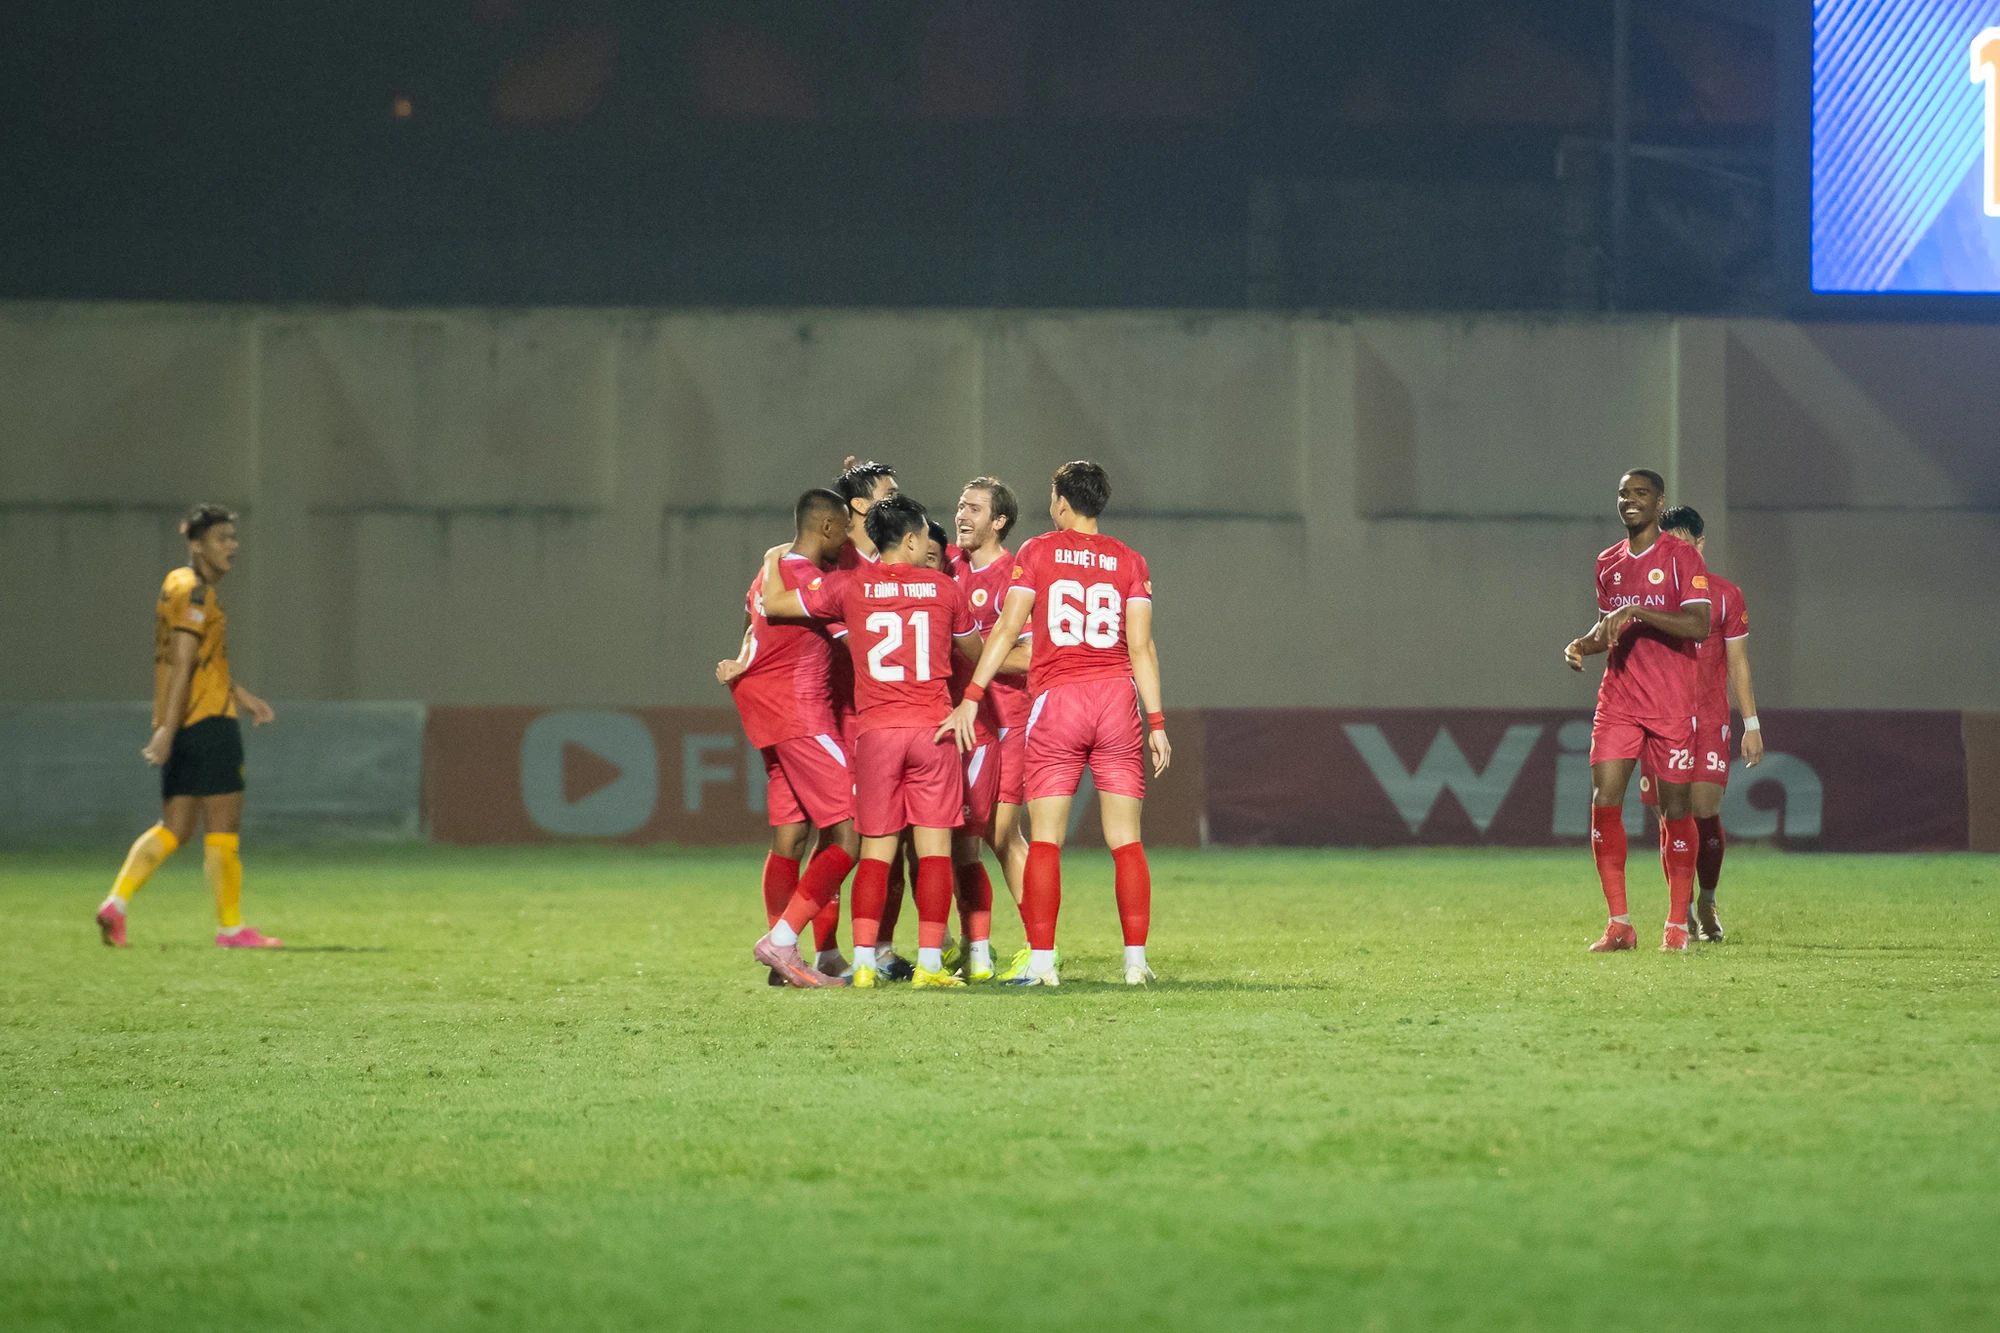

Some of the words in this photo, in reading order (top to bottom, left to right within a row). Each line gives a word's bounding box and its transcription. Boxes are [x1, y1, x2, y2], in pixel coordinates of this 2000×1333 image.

[1098, 553, 1117, 572] ANH
[901, 582, 937, 600] TRỌNG
[1609, 593, 1641, 607] CÔNG
[1644, 594, 1665, 606] AN
[1047, 578, 1121, 649] 68
[865, 610, 931, 682] 21
[1668, 748, 1689, 770] 72
[1706, 751, 1718, 770] 9
[1341, 722, 1823, 838] Wia
